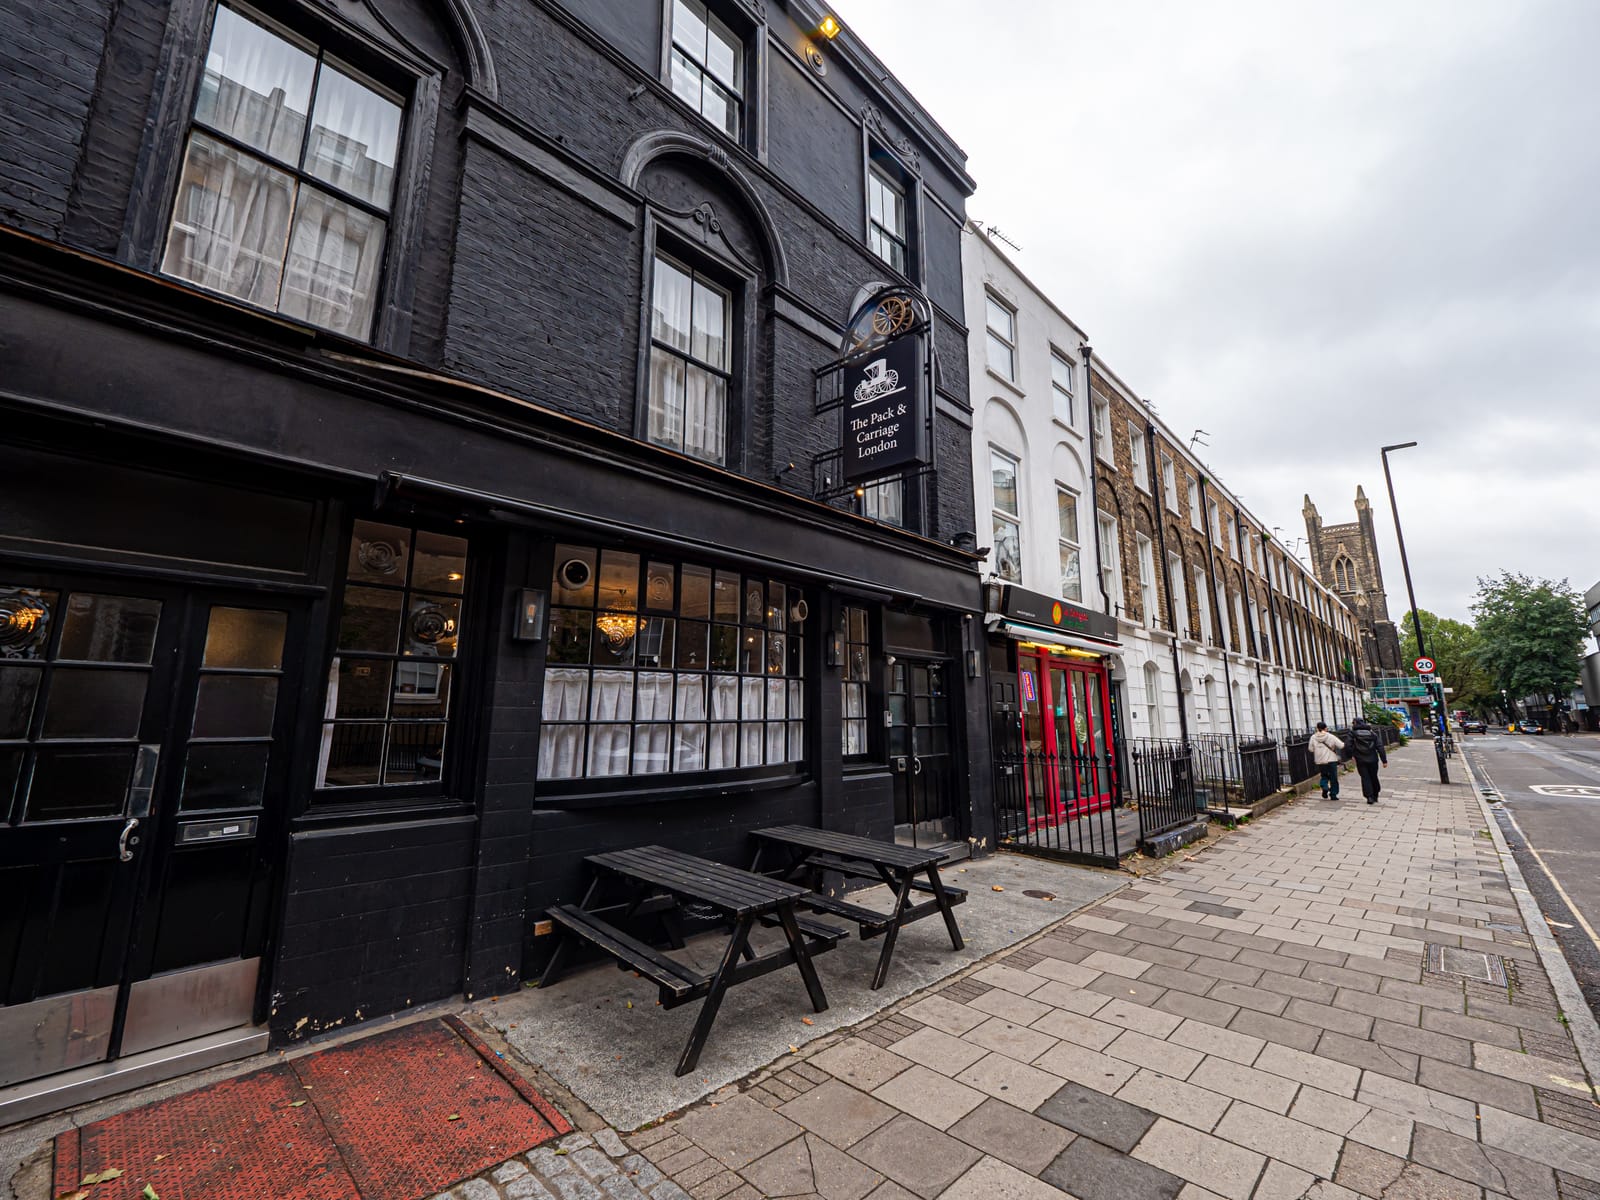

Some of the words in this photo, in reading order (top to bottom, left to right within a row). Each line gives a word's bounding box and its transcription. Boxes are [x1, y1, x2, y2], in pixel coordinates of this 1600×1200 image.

[850, 418, 868, 431] The
[871, 407, 894, 424] Pack
[897, 403, 907, 415] &
[856, 423, 899, 443] Carriage
[858, 439, 897, 458] London
[1417, 661, 1433, 669] 20
